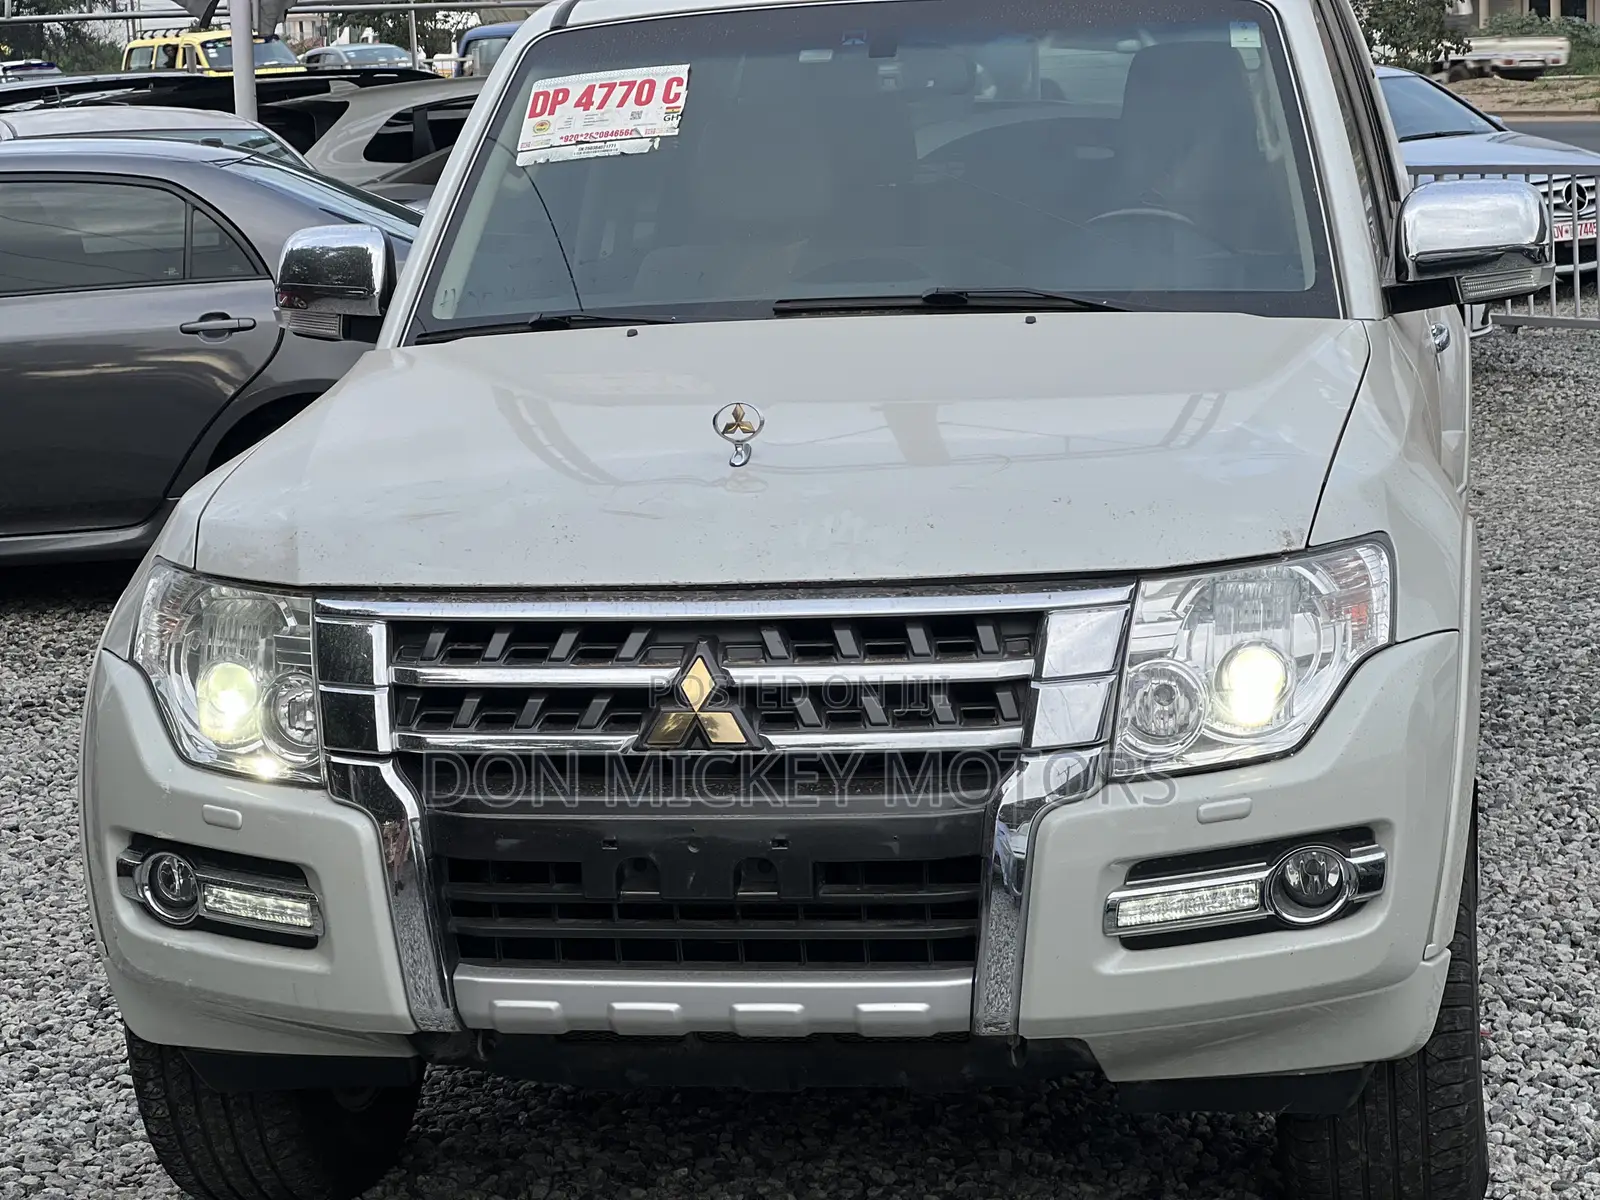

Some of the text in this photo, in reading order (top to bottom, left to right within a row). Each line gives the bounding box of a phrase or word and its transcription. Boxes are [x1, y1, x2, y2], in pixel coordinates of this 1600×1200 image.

[528, 76, 684, 119] DP 4770 C
